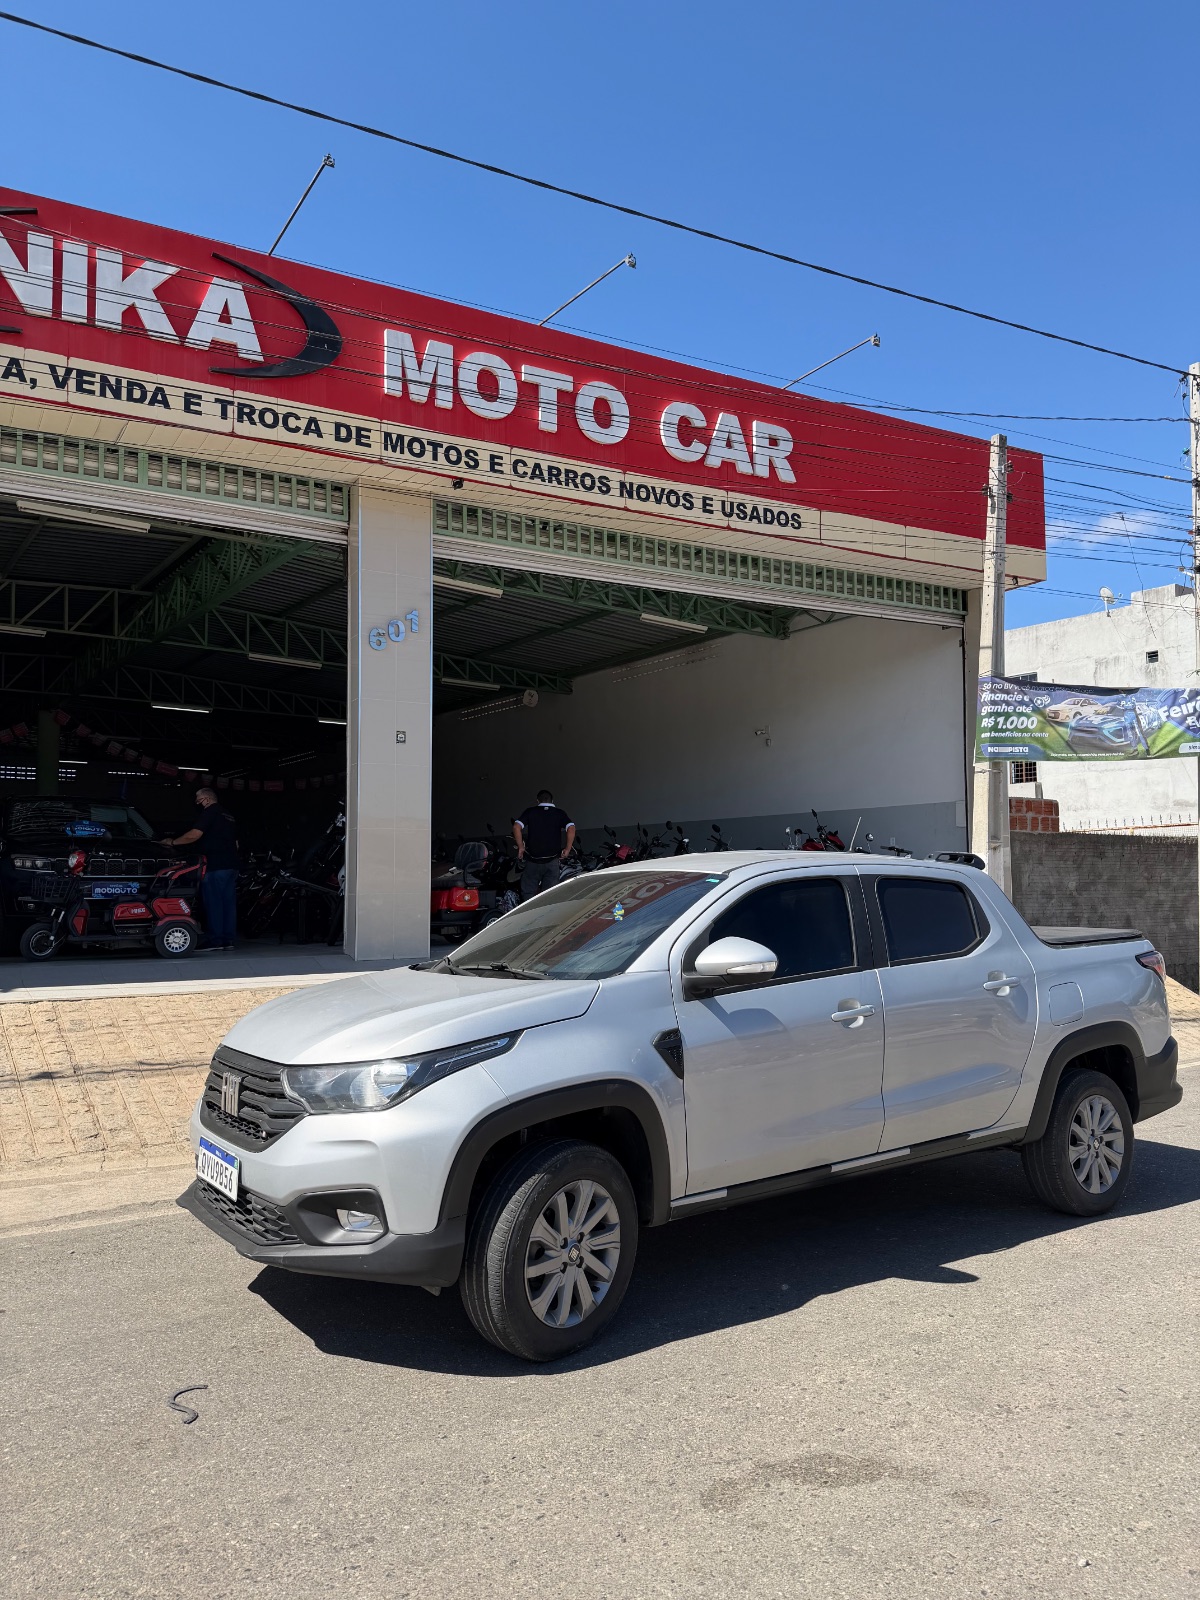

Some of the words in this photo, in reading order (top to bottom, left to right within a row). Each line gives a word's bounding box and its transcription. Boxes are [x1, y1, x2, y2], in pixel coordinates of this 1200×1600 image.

[383, 328, 630, 445] MOTO
[660, 401, 799, 484] CAR
[48, 364, 171, 410] VENDA
[183, 392, 203, 416] E
[215, 397, 324, 439] TROCA
[334, 421, 372, 449] DE
[383, 431, 480, 470] MOTOS
[489, 454, 504, 474] E
[512, 458, 611, 496] CARROS
[620, 481, 694, 511] NOVOS
[702, 496, 714, 515] E
[721, 499, 802, 530] USADOS
[369, 609, 419, 651] 601
[981, 692, 1023, 702] financie
[981, 704, 1015, 715] ganhe
[1016, 704, 1033, 713] até
[981, 716, 996, 728] R$
[996, 716, 1038, 729] 1.000
